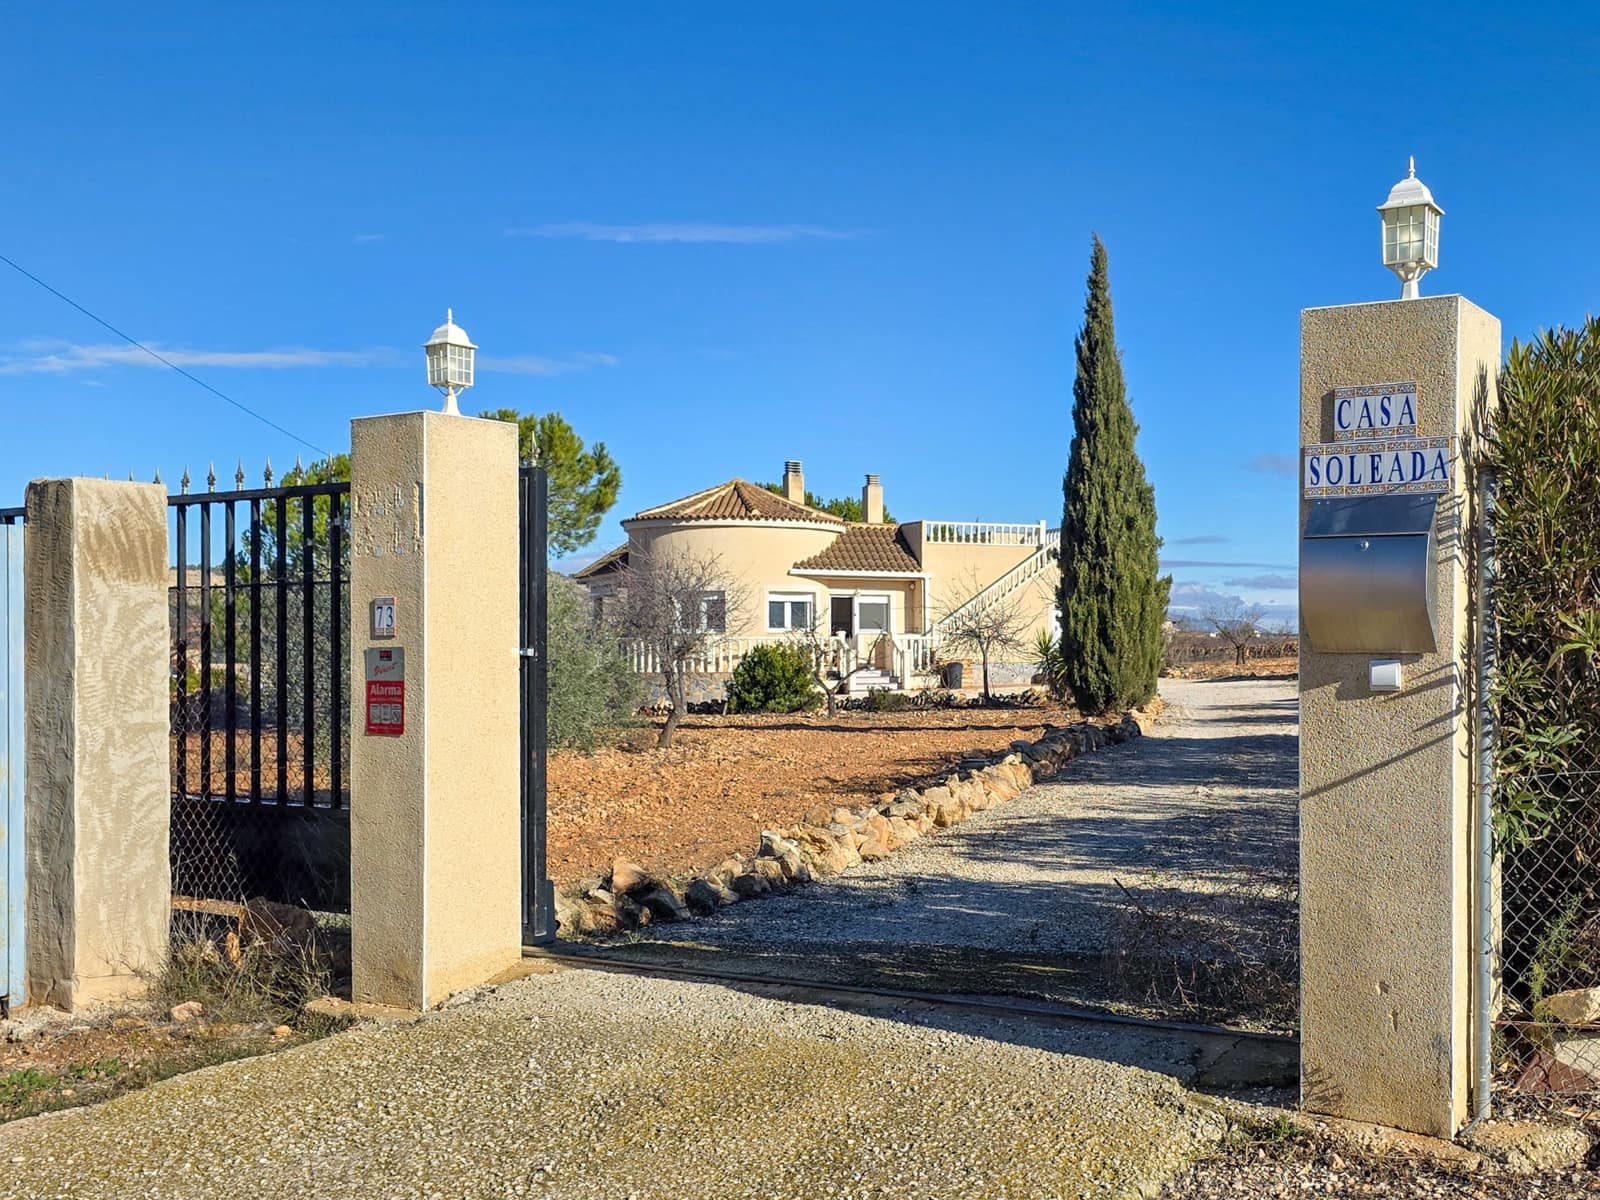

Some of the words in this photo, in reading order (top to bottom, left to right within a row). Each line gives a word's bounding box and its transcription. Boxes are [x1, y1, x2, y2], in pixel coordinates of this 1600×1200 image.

[1337, 395, 1415, 430] CASA
[1310, 450, 1447, 486] SOLEADA
[375, 606, 394, 628] 73
[370, 683, 402, 695] Alarma
